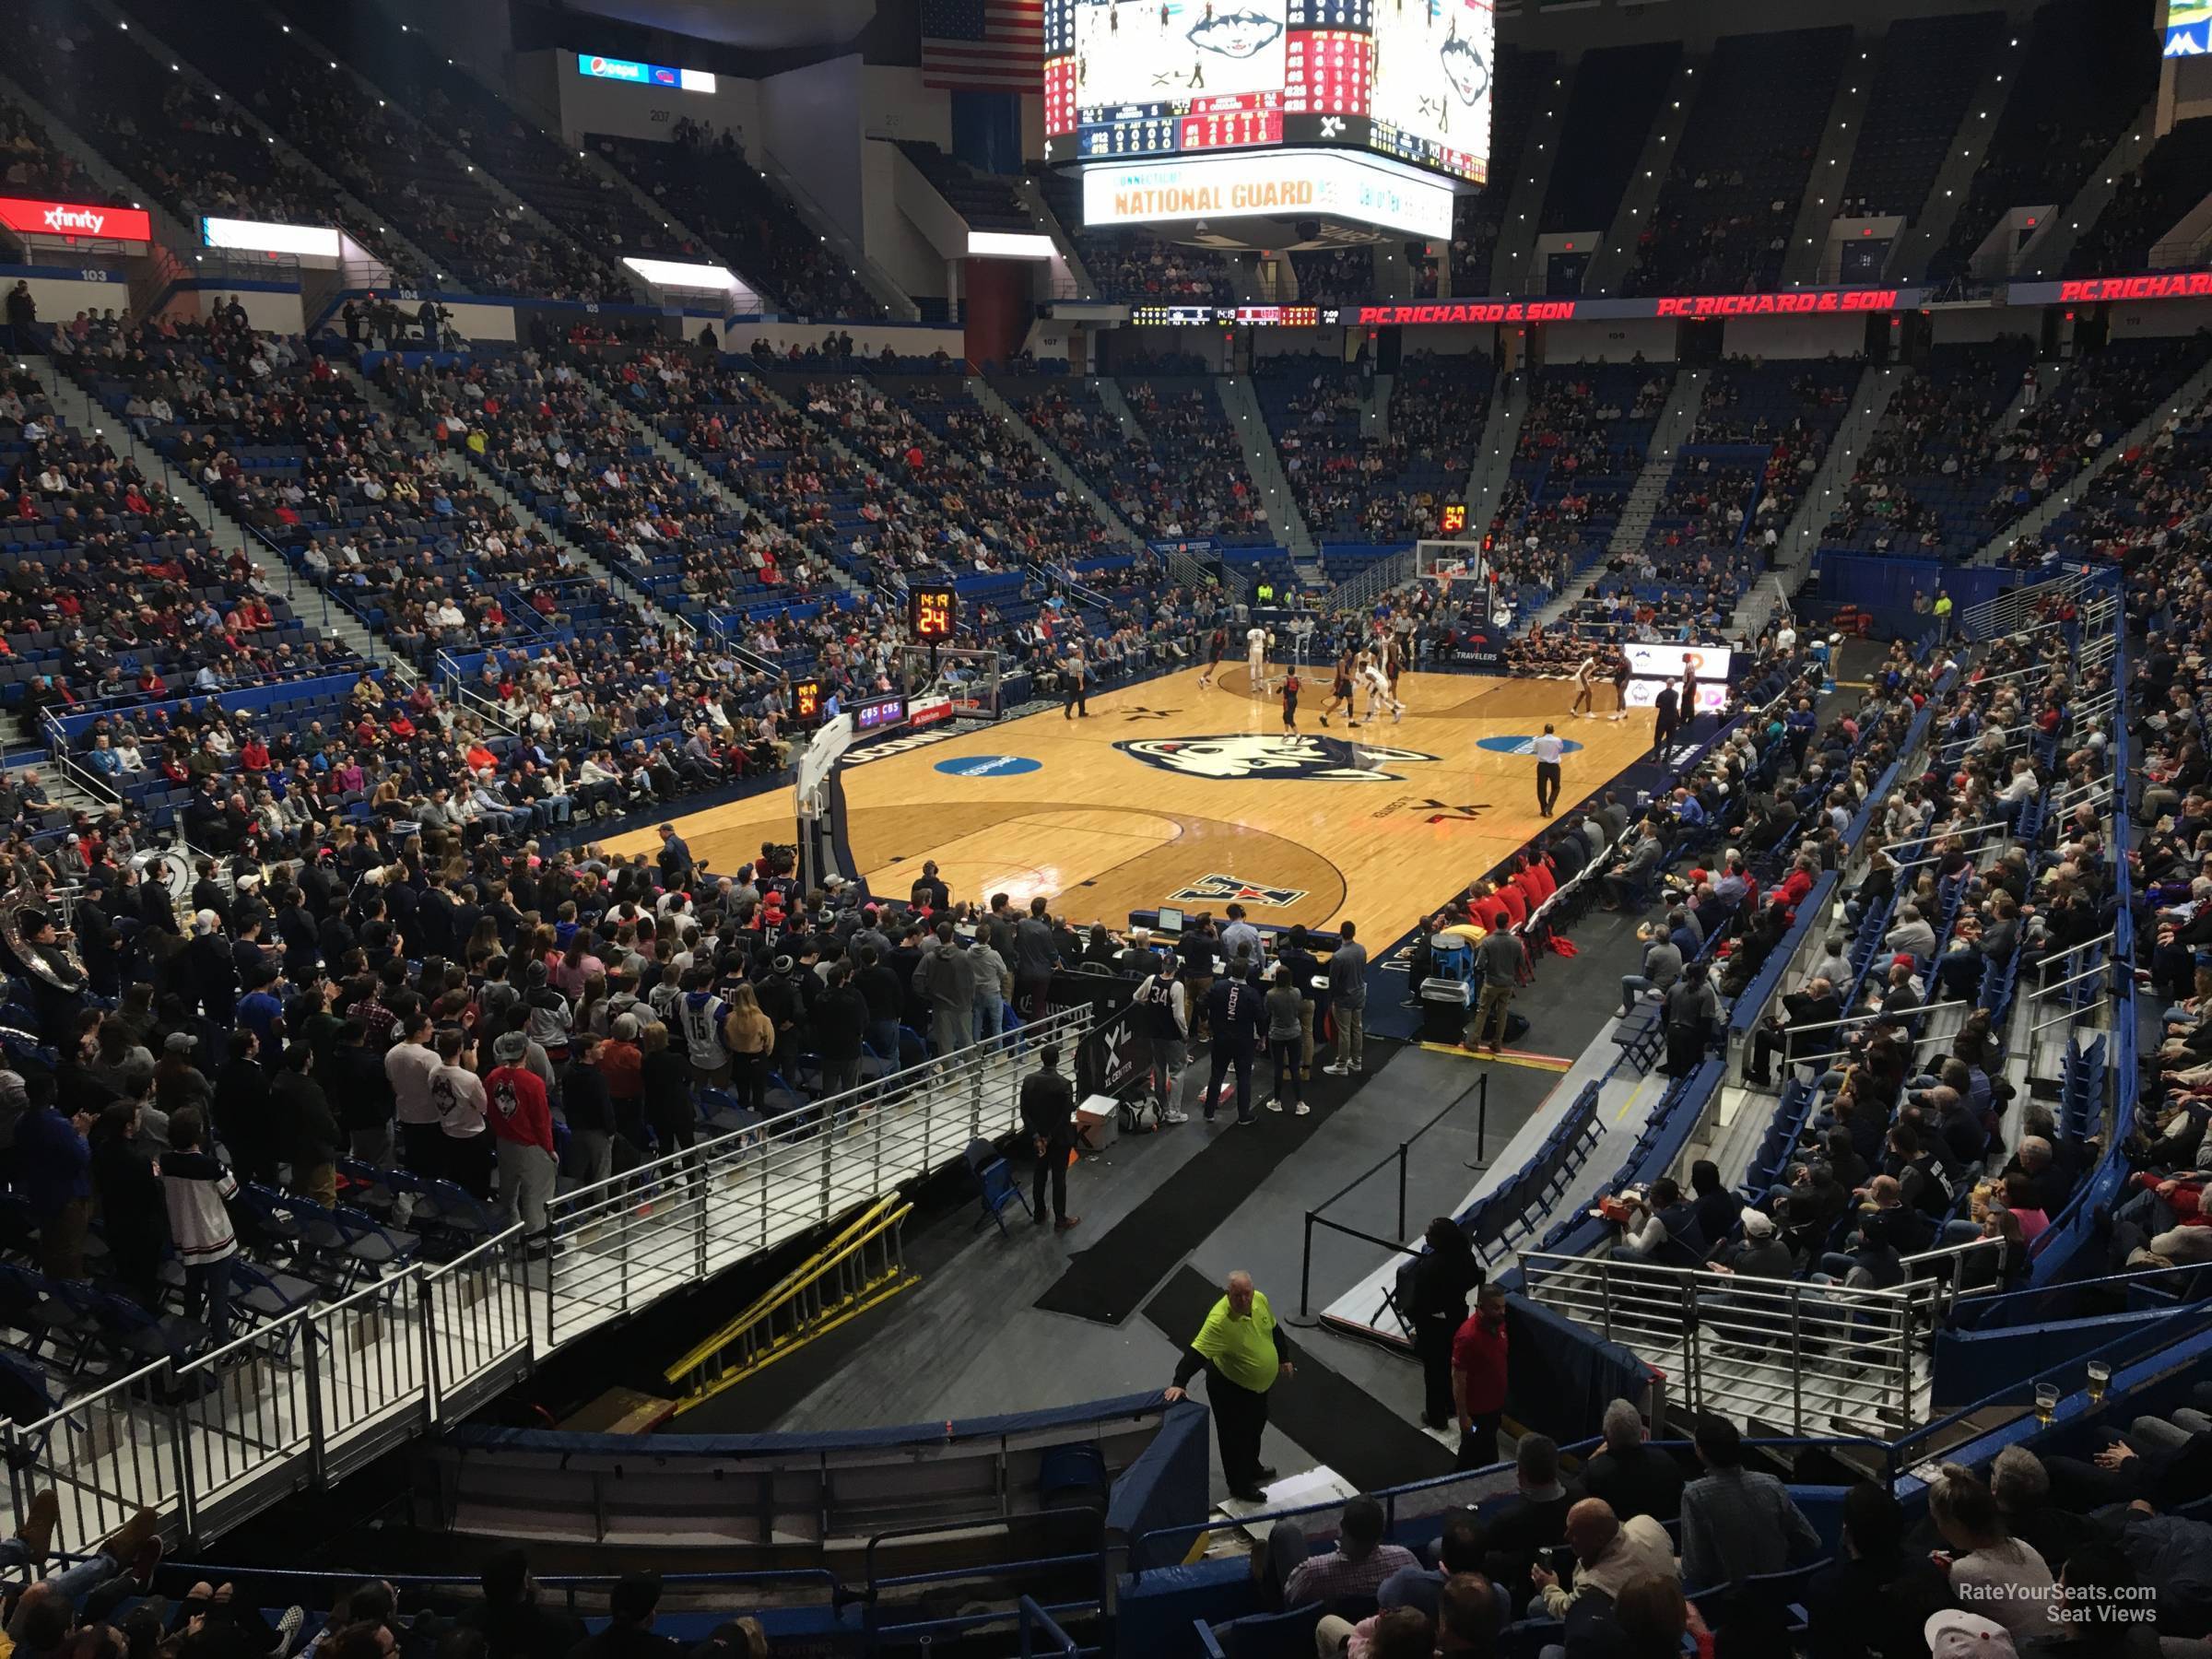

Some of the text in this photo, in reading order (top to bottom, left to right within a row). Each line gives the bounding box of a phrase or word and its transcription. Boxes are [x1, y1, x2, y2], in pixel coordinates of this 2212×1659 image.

[650, 109, 670, 123] 207
[1320, 116, 1347, 137] XL
[1116, 131, 1124, 142] 0
[1132, 129, 1140, 140] 0
[1147, 128, 1156, 139] 0
[1163, 127, 1171, 137] 0
[1132, 141, 1140, 151] 0
[1147, 139, 1156, 150] 0
[1163, 138, 1171, 148] 0
[1115, 181, 1312, 216] NATIONAL GUARD
[44, 206, 104, 233] xfinity
[81, 269, 107, 282] 103
[400, 289, 418, 300] 104
[2060, 272, 2212, 301] P.C. RICHAR
[1359, 302, 1575, 323] P.C. RICHARD & SON
[1657, 290, 1898, 315] P.C. RICHARD & SON
[1217, 309, 1235, 319] 14:19
[1445, 515, 1463, 529] 24
[921, 594, 949, 607] 14:19
[921, 607, 946, 632] 24
[1456, 652, 1498, 662] TRAVELERS
[798, 684, 818, 697] 14:19
[801, 698, 814, 714] 24
[861, 701, 900, 721] CBS CBS
[841, 731, 956, 763] UCONN
[765, 926, 780, 947] 15
[1151, 985, 1168, 1006] 34
[1227, 986, 1240, 1020] UCONN
[691, 1017, 707, 1040] 15
[1105, 1019, 1132, 1076] XL
[1112, 1061, 1133, 1083] CENTER
